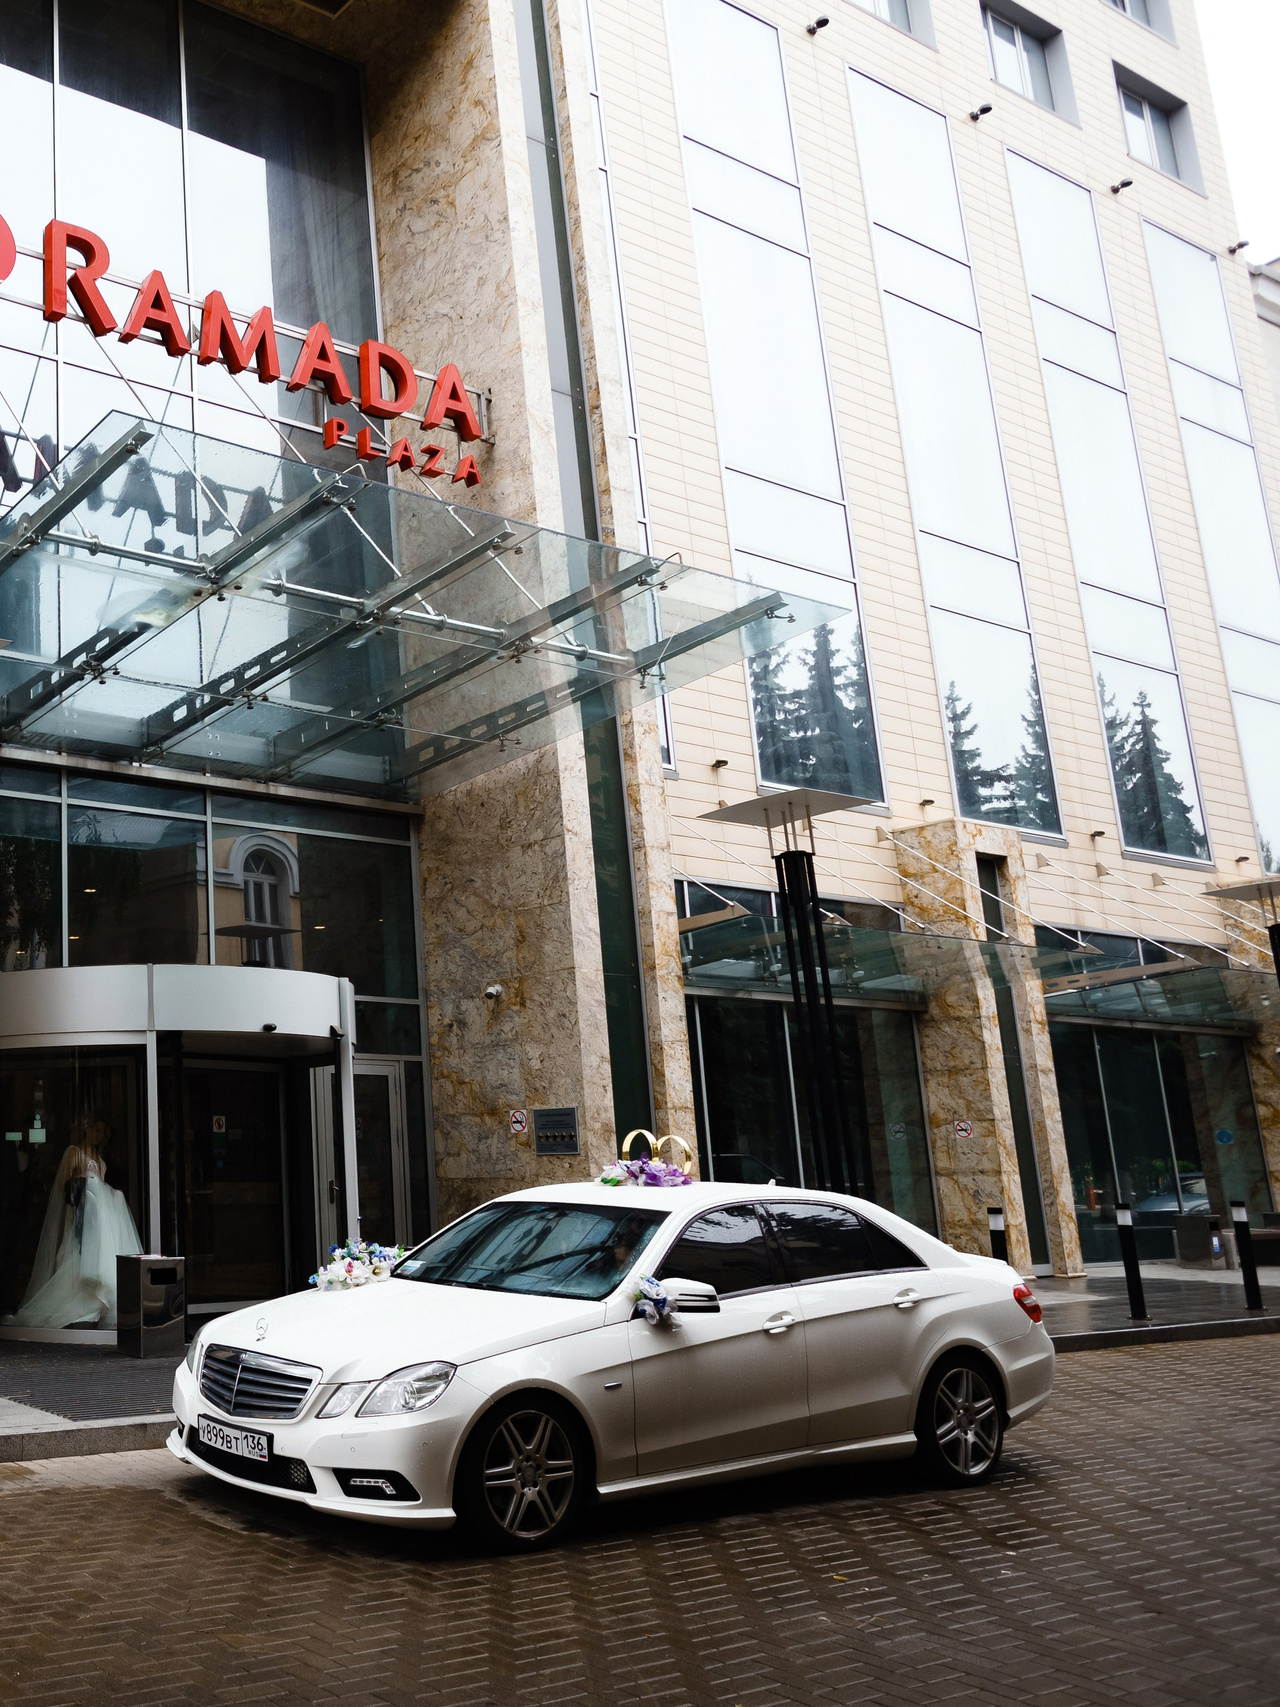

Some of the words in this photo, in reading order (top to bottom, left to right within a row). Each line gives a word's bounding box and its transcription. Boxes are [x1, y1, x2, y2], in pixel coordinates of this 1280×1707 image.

[43, 218, 482, 442] RAMADA
[324, 417, 482, 488] PLAZA
[243, 1434, 264, 1452] 136
